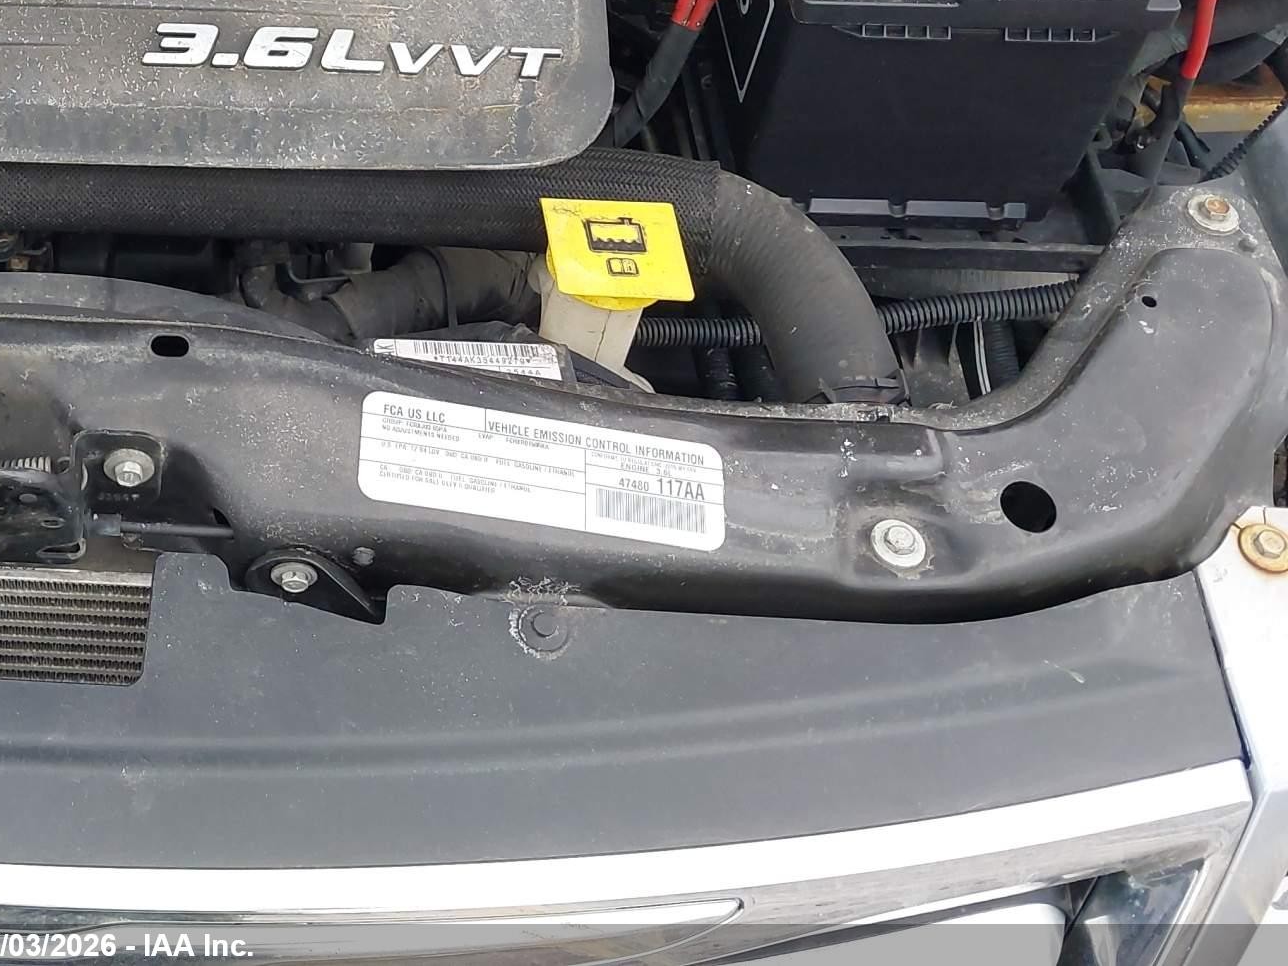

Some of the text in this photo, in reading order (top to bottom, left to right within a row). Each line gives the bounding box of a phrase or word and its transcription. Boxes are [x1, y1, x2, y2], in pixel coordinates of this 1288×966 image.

[388, 41, 562, 79] VVT
[384, 404, 446, 424] FCA US LLC
[488, 420, 530, 437] VEHICLE
[534, 428, 582, 446] EMISSION
[586, 437, 631, 454] CONTROL
[636, 444, 704, 466] INFORMATION
[620, 462, 648, 474] ENGINE
[656, 478, 705, 500] 117AA
